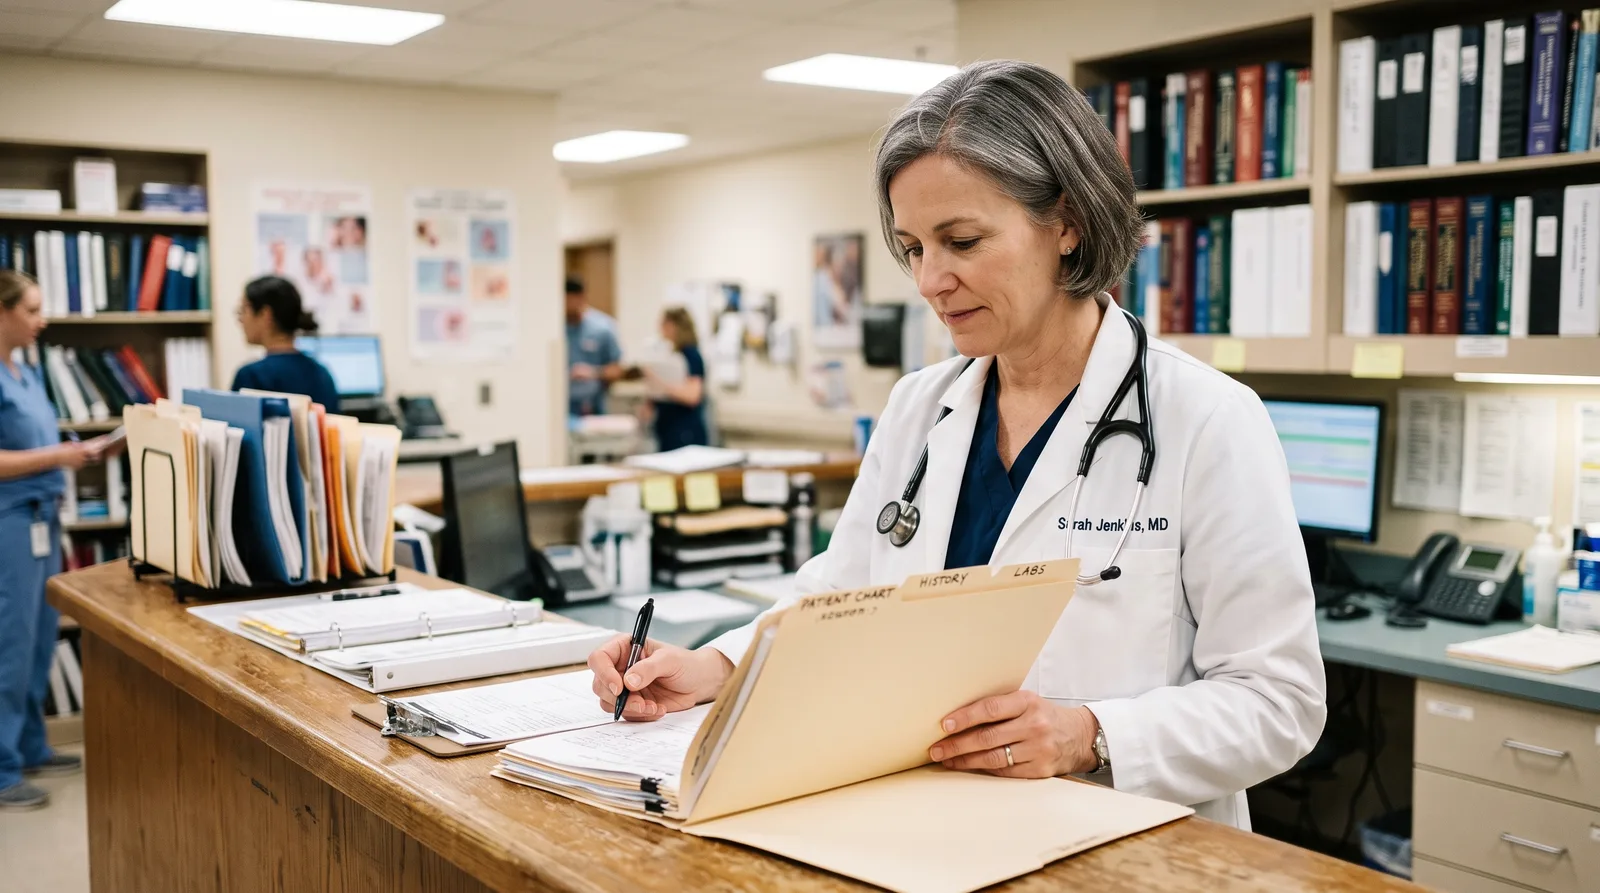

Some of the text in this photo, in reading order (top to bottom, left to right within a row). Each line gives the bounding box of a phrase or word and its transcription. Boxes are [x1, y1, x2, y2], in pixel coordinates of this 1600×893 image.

[1148, 517, 1169, 531] MD
[1013, 564, 1047, 577] LABS
[919, 572, 969, 588] HISTORY
[800, 587, 896, 611] PATIENT CHART
